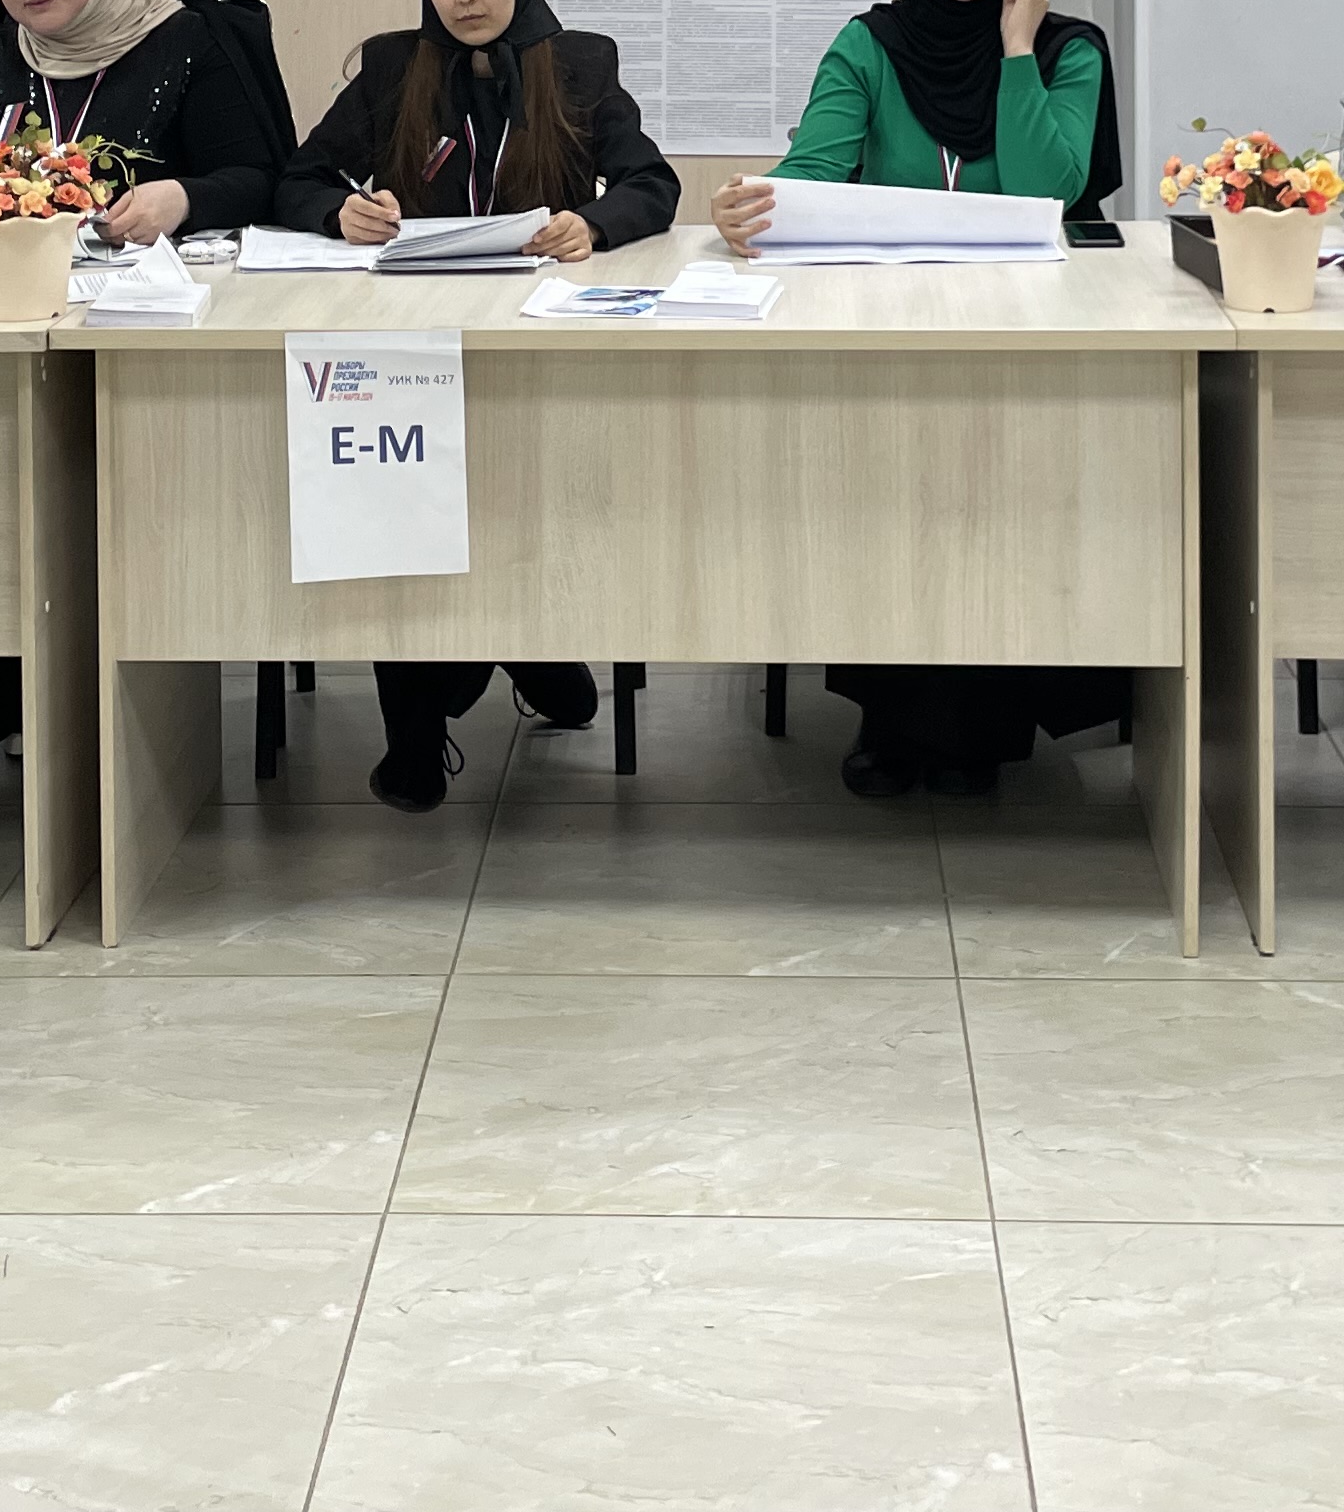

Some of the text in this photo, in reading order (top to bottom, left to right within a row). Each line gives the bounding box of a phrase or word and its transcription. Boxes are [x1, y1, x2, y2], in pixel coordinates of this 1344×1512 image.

[336, 361, 366, 370] ВЫБОРЫ
[333, 370, 378, 381] ПРЕЗИДЕНТА
[388, 374, 455, 386] УИК № 427
[330, 382, 360, 392] РОССИИ
[332, 424, 424, 465] Е-М
